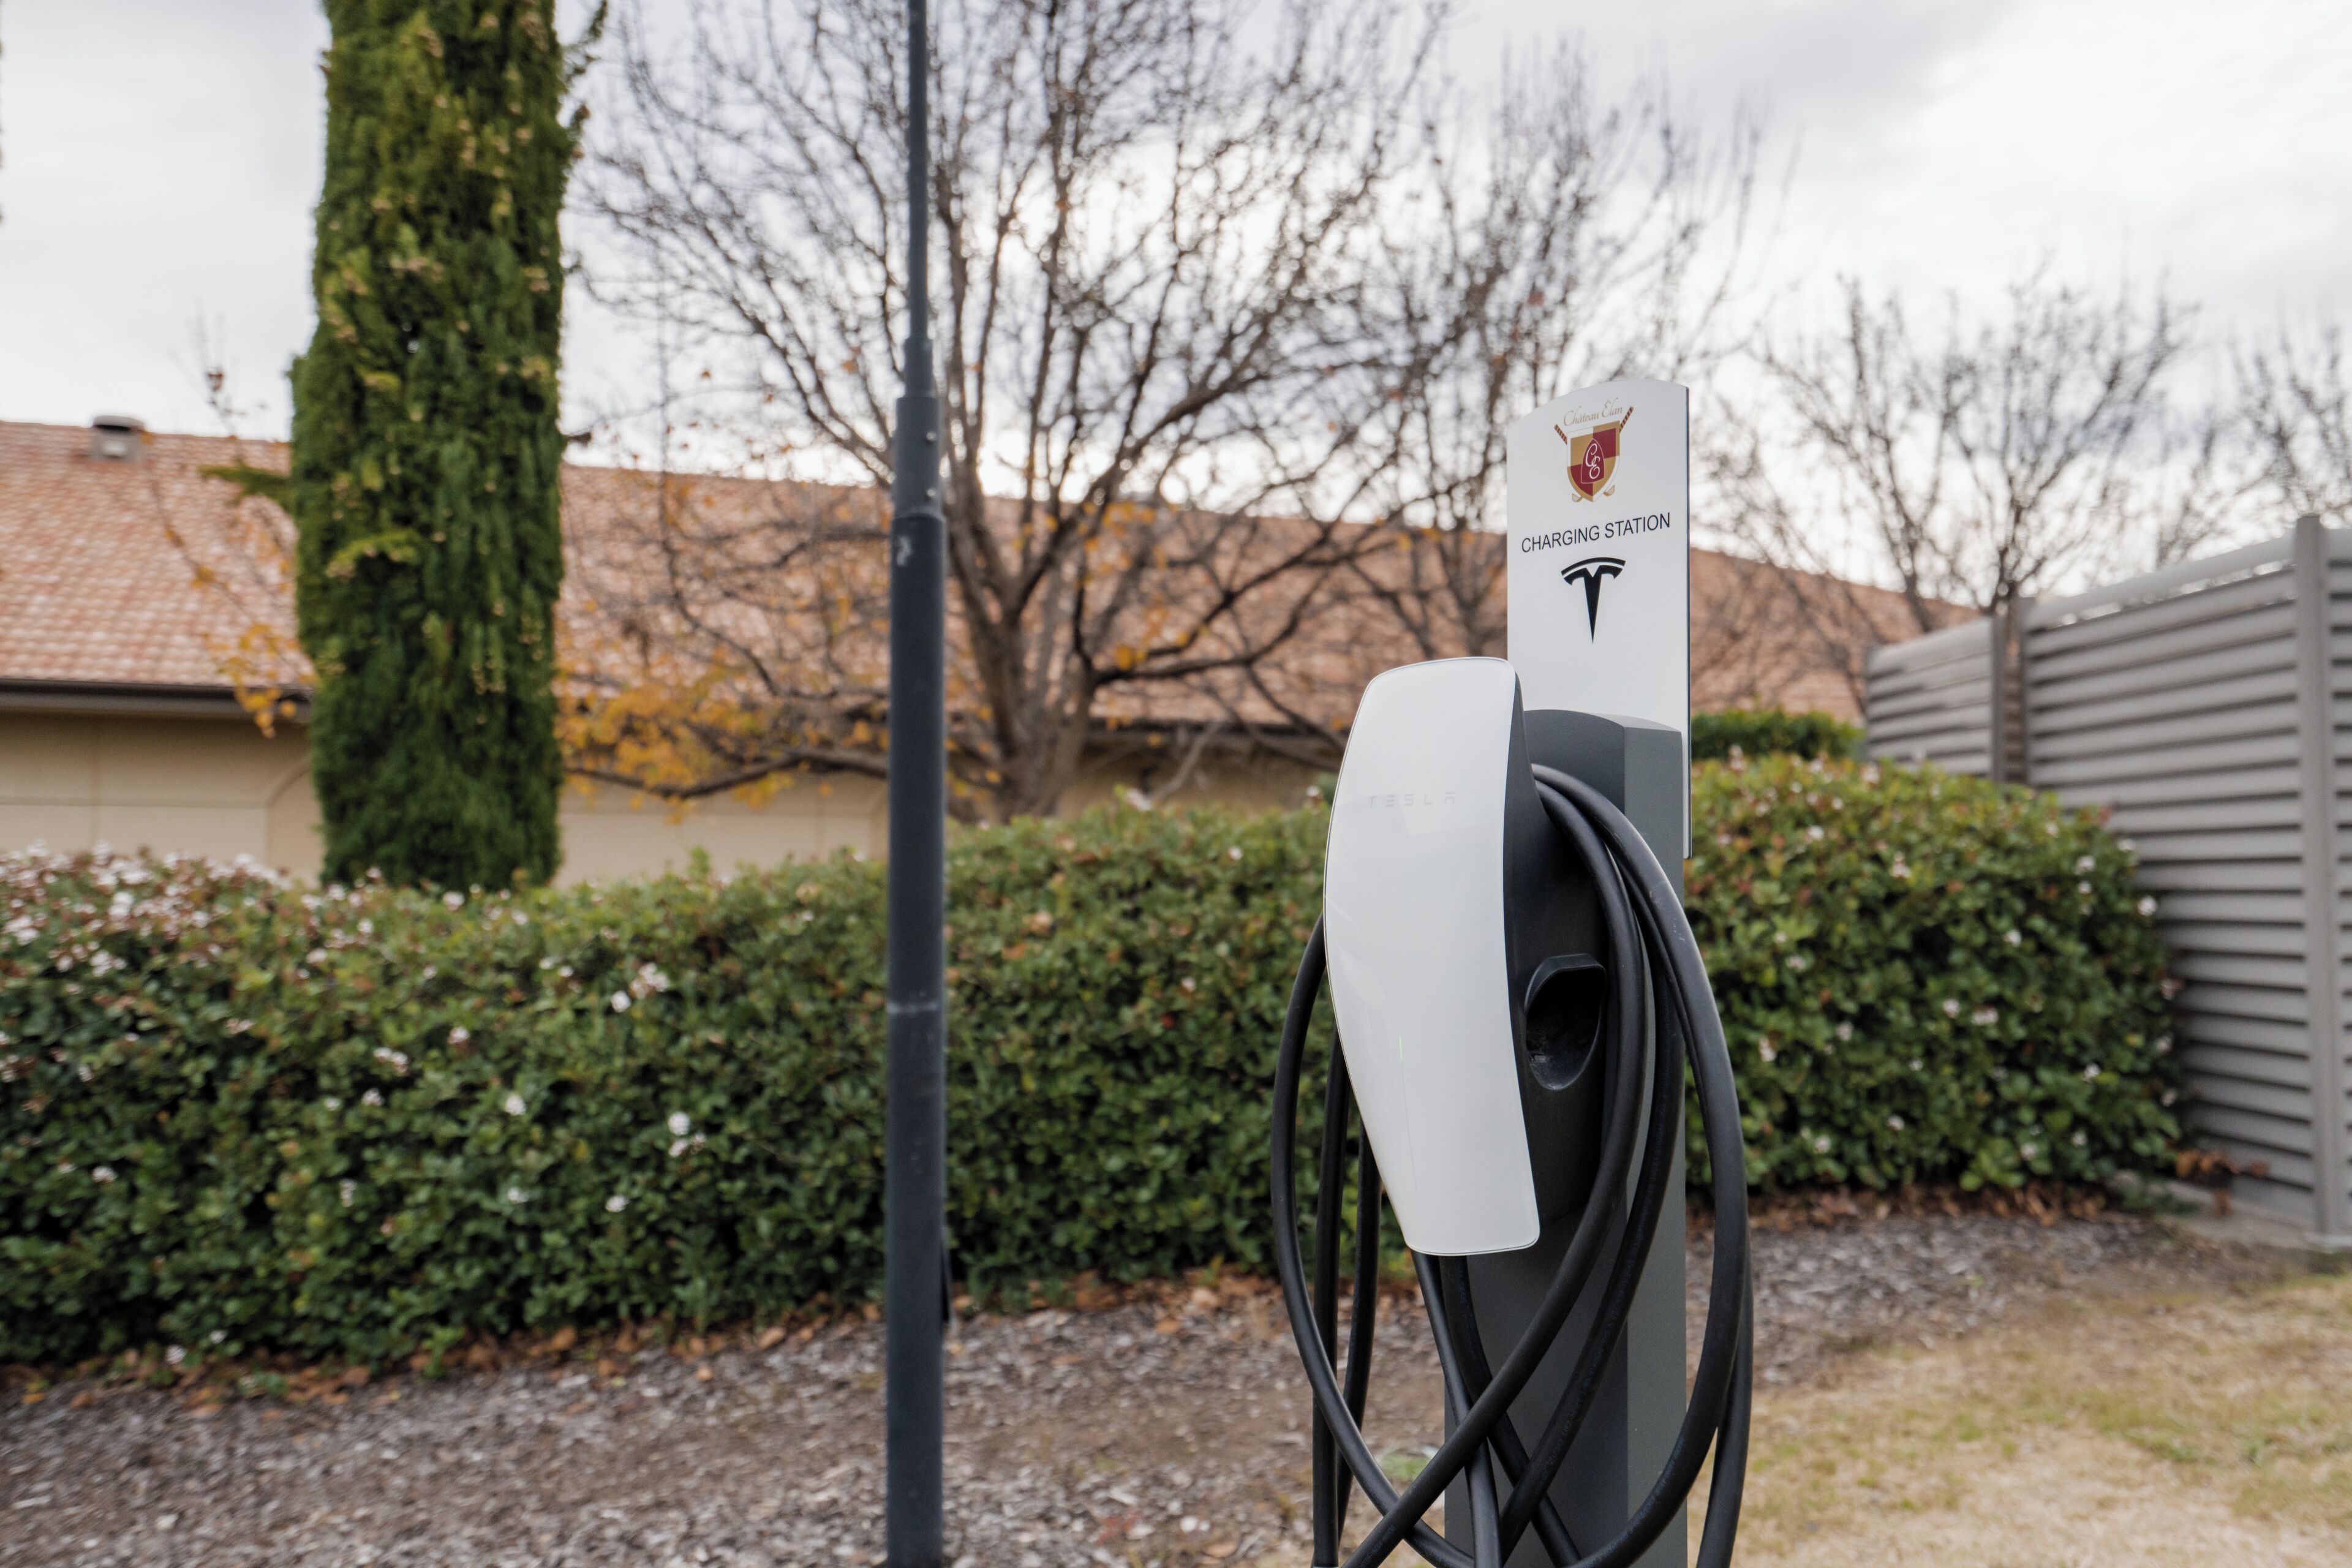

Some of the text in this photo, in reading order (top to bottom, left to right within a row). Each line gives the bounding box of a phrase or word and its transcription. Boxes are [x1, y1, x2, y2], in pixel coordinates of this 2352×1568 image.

[1563, 405, 1600, 426] Château
[1521, 512, 1671, 553] CHARGING STATION
[1368, 791, 1457, 809] TESLA
